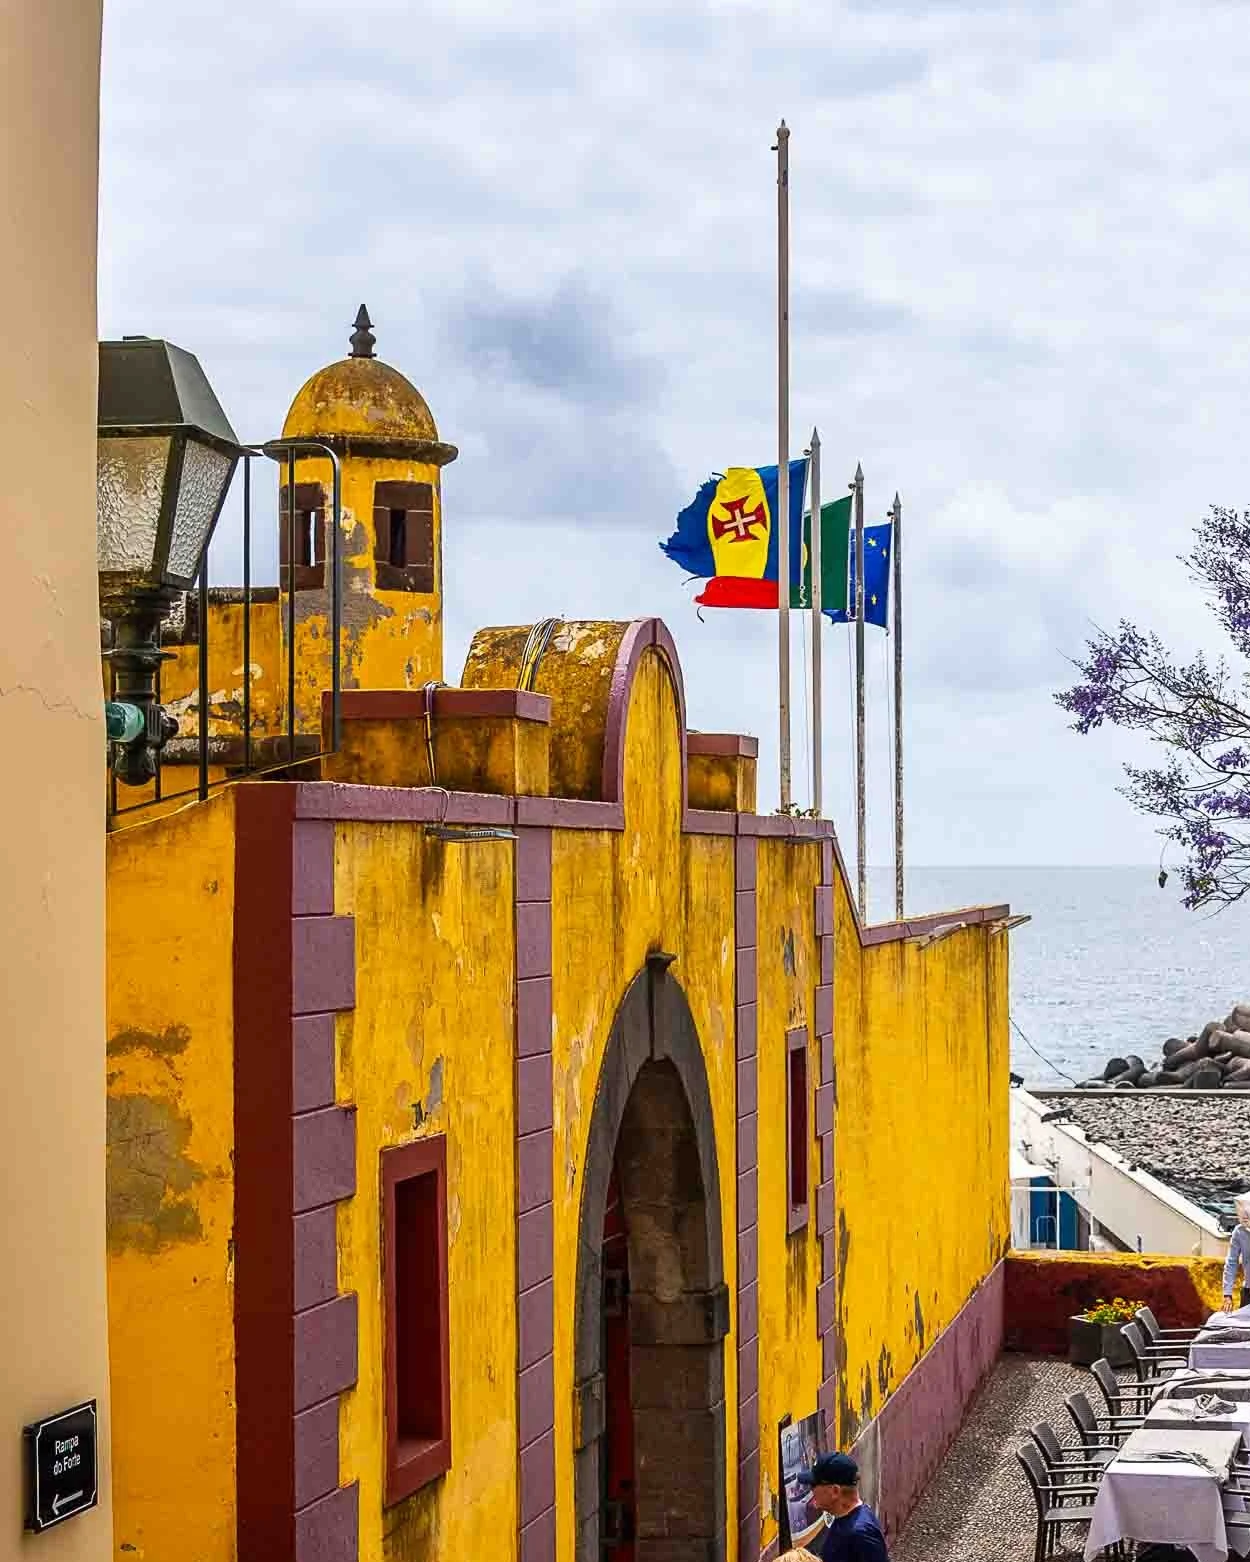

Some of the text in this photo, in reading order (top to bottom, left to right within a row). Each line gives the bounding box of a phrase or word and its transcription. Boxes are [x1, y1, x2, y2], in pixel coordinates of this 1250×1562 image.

[55, 1436, 79, 1455] Rampa
[53, 1453, 81, 1475] do Forte
